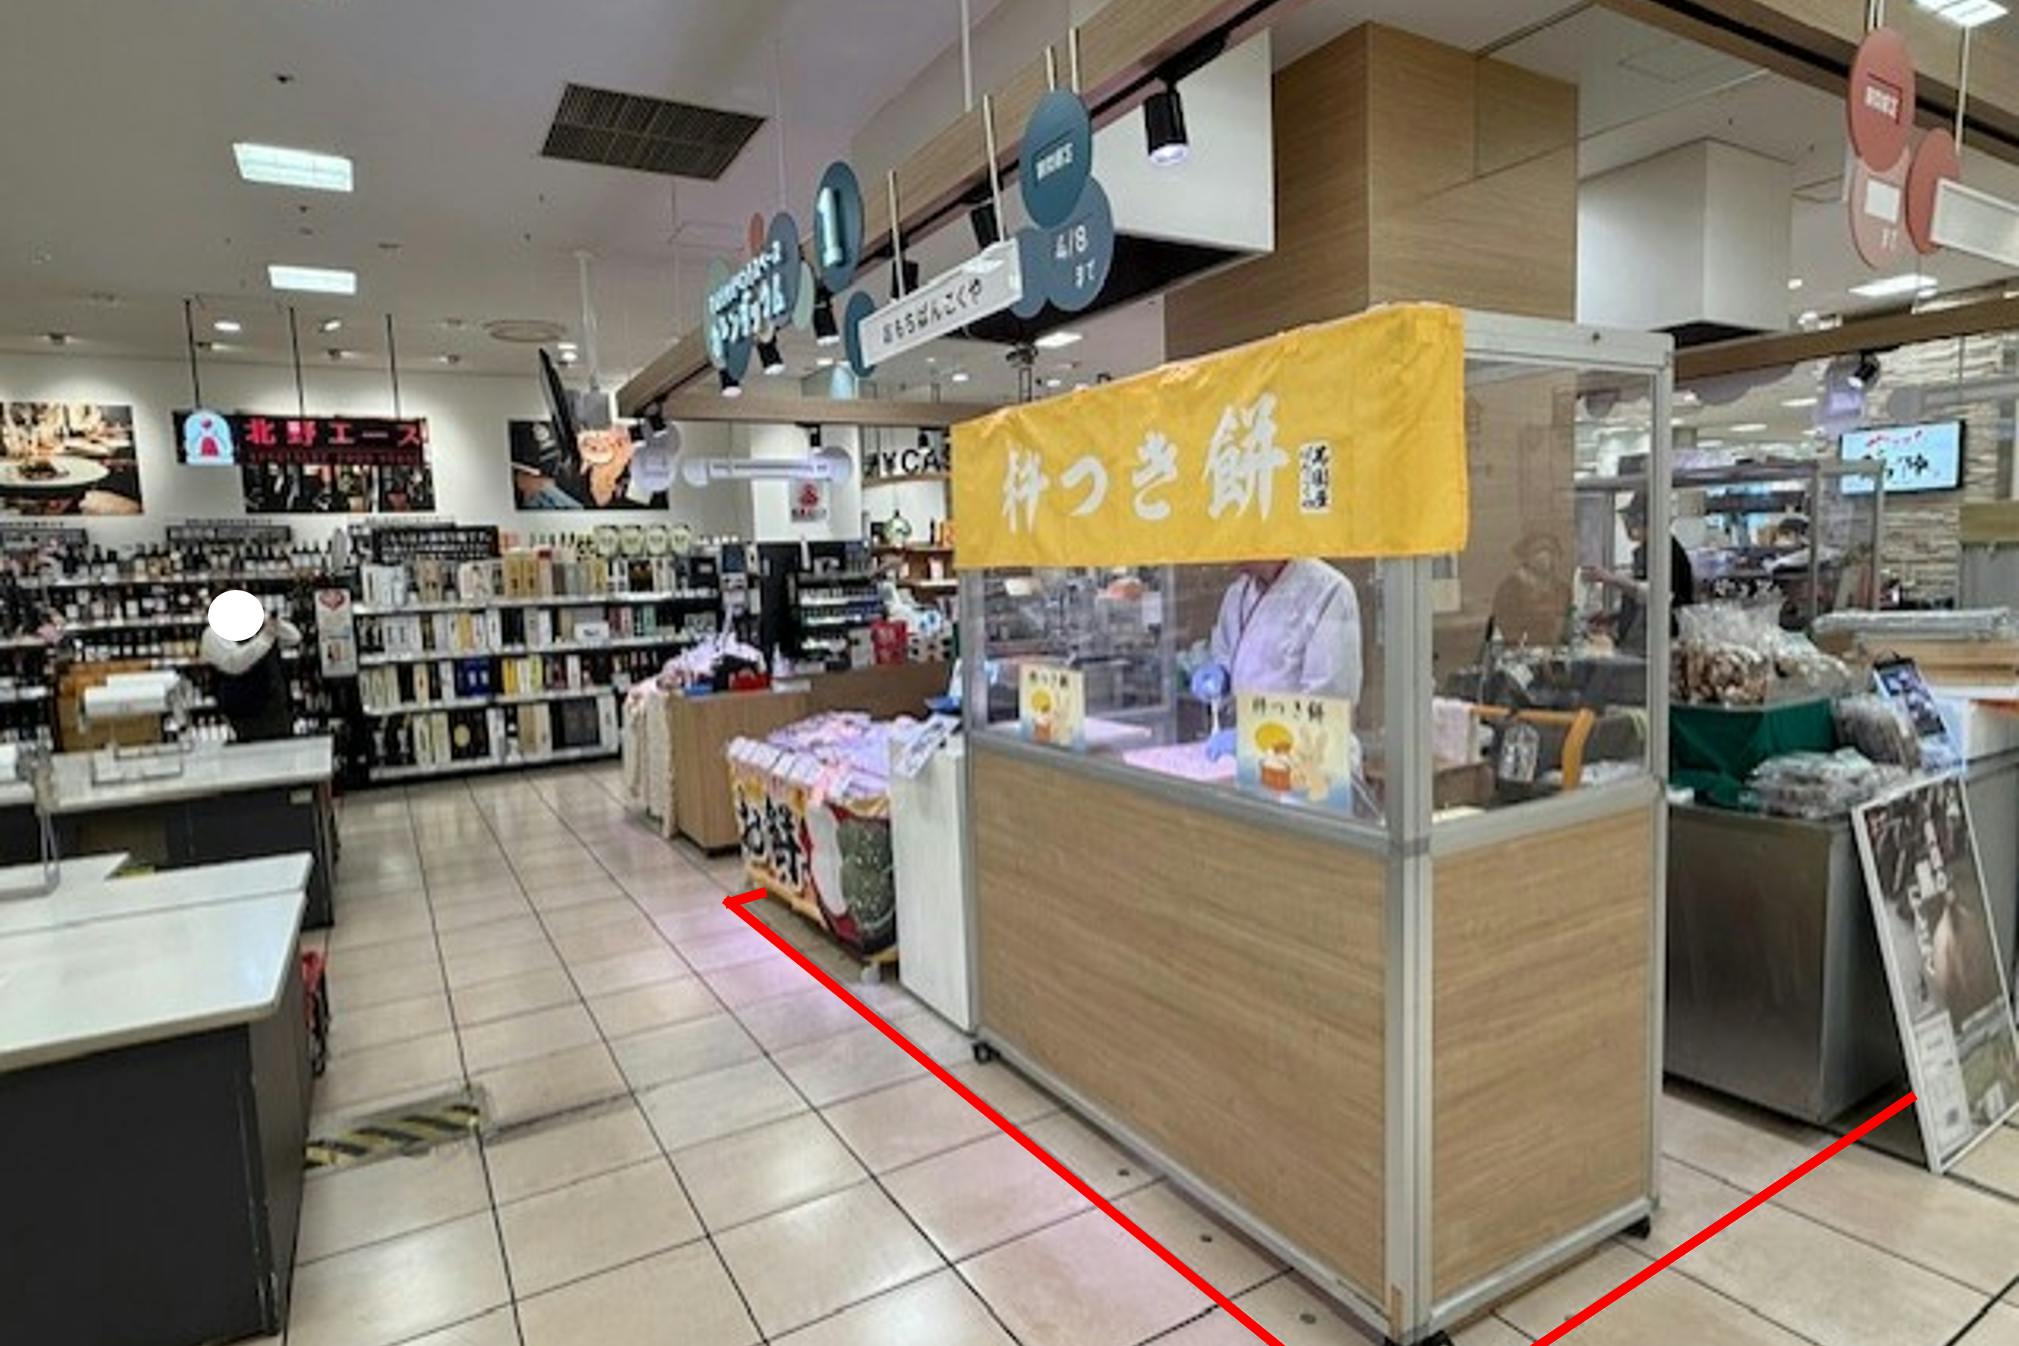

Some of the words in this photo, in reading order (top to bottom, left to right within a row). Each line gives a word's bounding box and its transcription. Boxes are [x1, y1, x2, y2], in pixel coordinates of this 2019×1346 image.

[1055, 224, 1088, 260] 4/8
[245, 417, 422, 446] 北野エース
[1001, 390, 1290, 535] 杵つき餅
